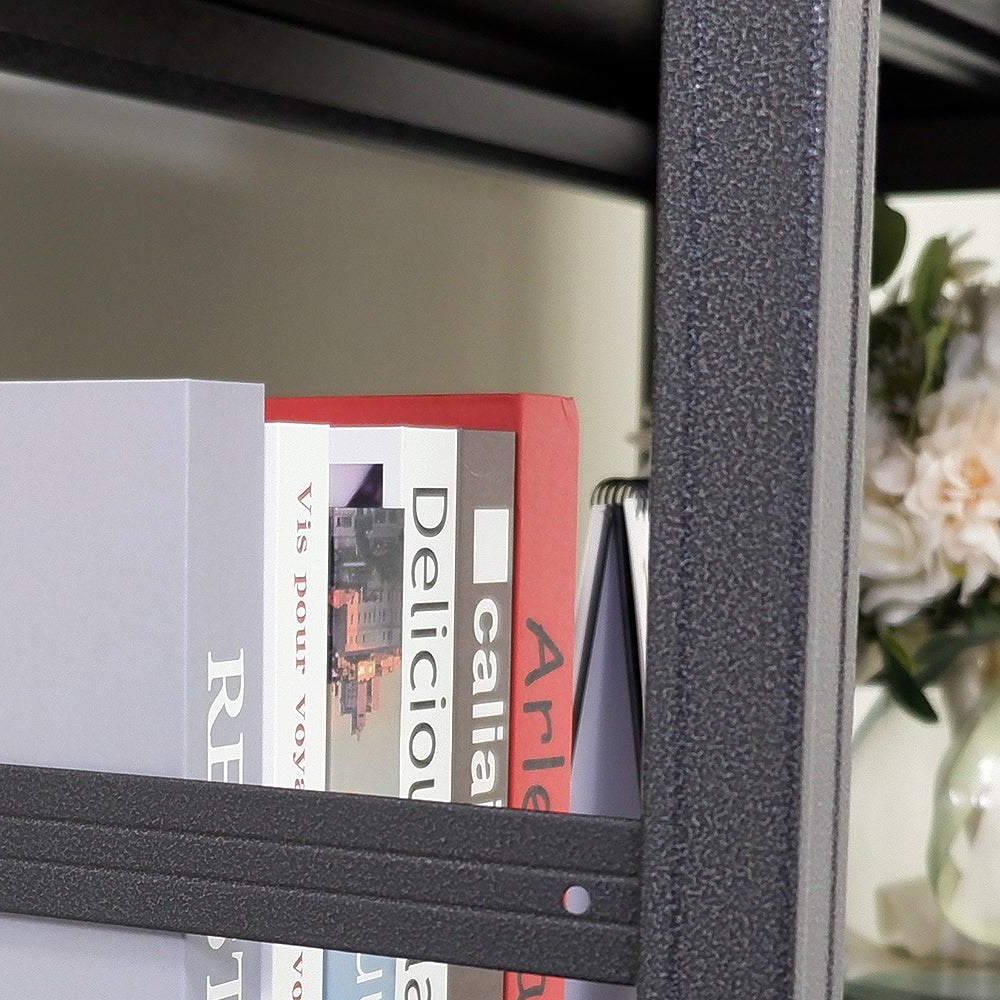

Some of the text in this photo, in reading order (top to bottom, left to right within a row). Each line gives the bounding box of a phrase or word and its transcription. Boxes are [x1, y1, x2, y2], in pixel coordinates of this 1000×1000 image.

[291, 481, 313, 790] Vis pour voya
[409, 487, 449, 799] Deliciou
[470, 597, 504, 808] calia
